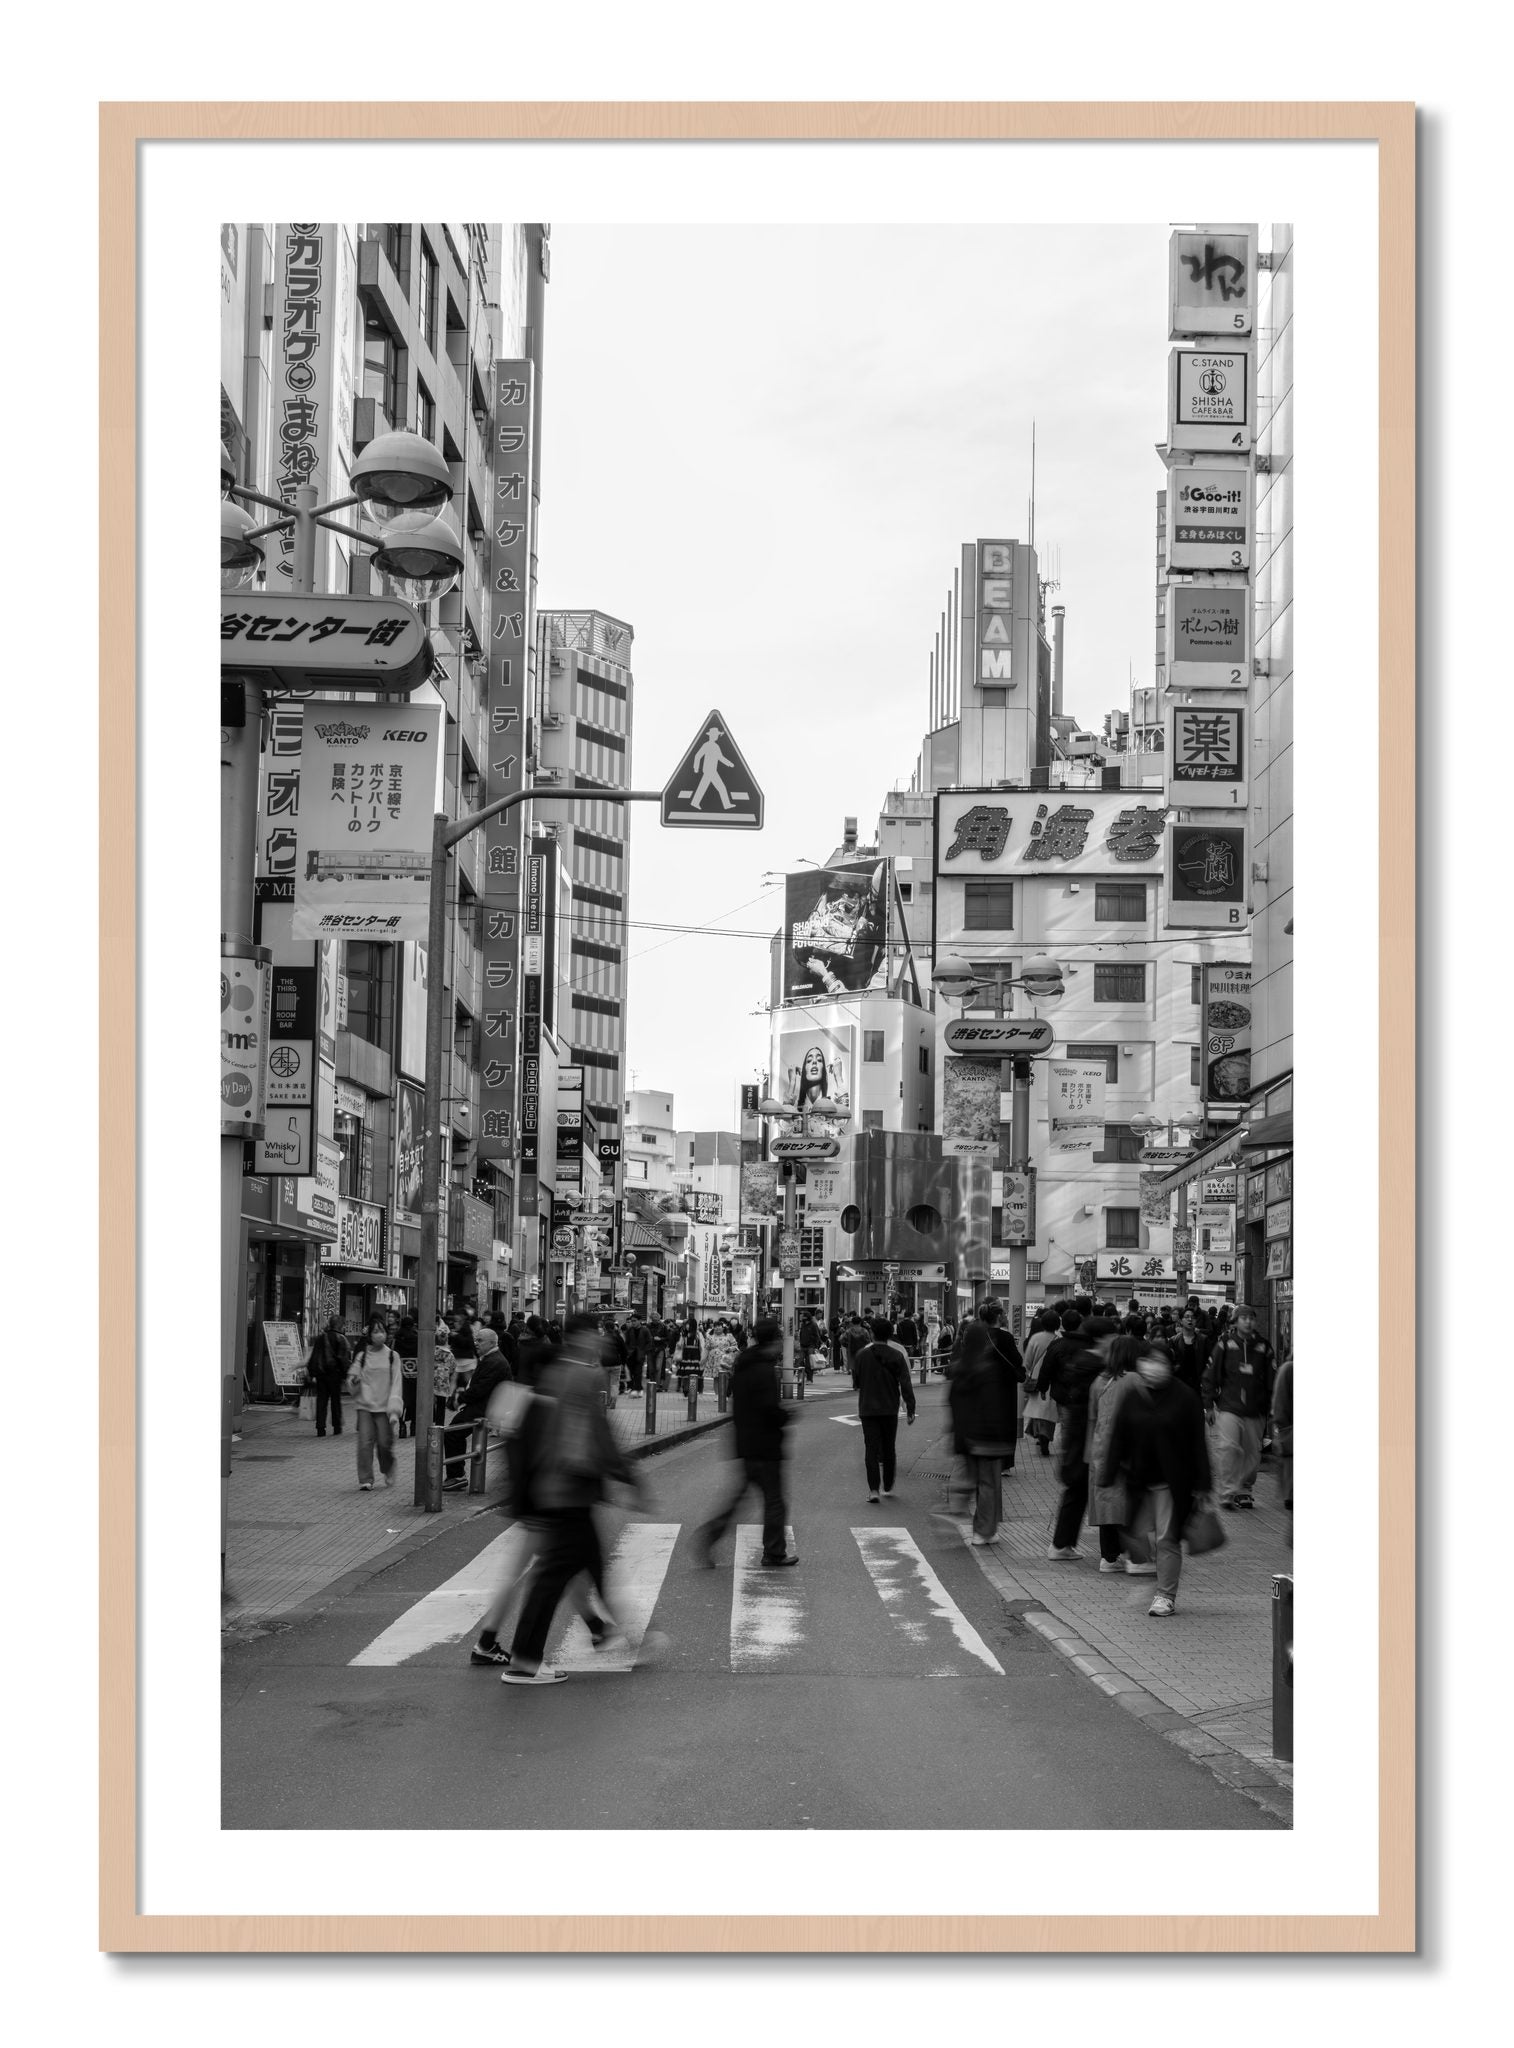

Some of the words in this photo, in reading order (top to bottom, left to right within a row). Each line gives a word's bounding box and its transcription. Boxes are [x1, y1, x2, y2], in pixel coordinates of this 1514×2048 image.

[283, 235, 323, 363] カラオケ
[1233, 315, 1245, 329] 5
[1192, 359, 1234, 367] C.STAND
[1192, 397, 1234, 406] SHISHA
[1184, 506, 1238, 514] 渋谷宇田川町店
[1180, 530, 1242, 541] 全身もみほぐし
[1231, 550, 1242, 566] 3
[981, 544, 1012, 678] BEAM
[1230, 669, 1242, 684] 2
[382, 729, 428, 742] KEIO
[1184, 714, 1230, 762] 薬
[331, 763, 346, 803] 冒険へ
[348, 763, 364, 833] カントーの
[387, 764, 403, 820] 京王線で
[1230, 789, 1238, 803] 1
[945, 805, 1169, 861] 角海老
[530, 860, 538, 894] kimono
[318, 914, 402, 928] 渋谷センター街
[1229, 909, 1240, 923] B
[1210, 982, 1251, 994] 四川料理
[952, 1028, 1047, 1040] 渋谷センター街
[1208, 1036, 1235, 1054] 6F
[264, 1150, 284, 1158] Bank
[265, 1142, 296, 1152] Whisky
[600, 1145, 619, 1155] GU
